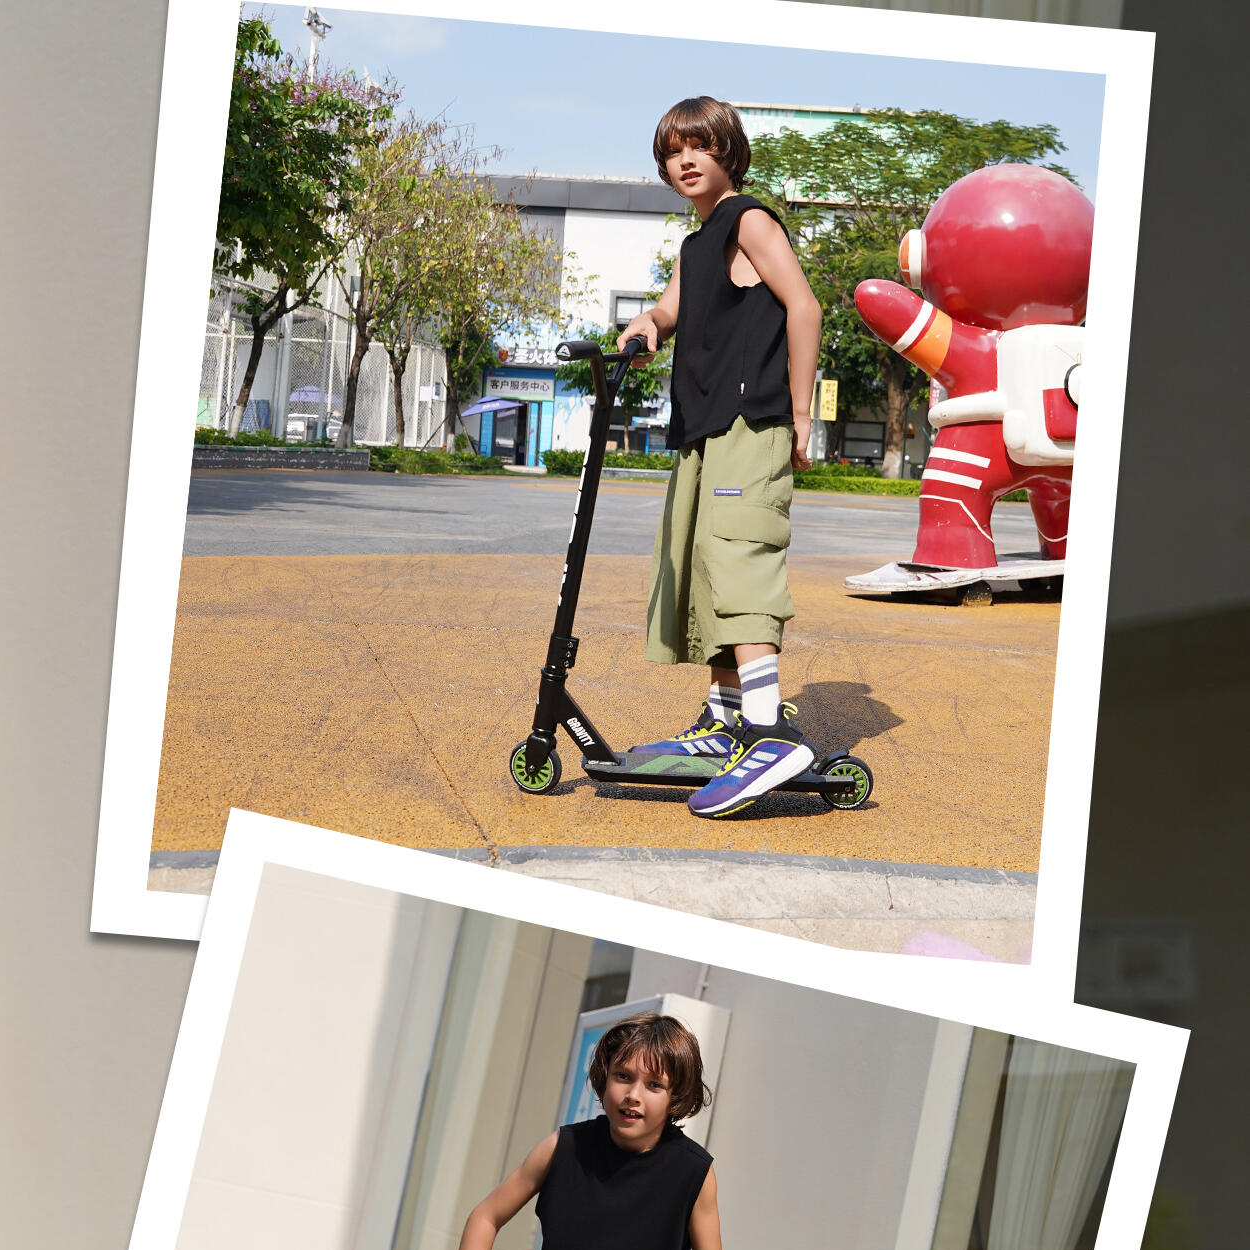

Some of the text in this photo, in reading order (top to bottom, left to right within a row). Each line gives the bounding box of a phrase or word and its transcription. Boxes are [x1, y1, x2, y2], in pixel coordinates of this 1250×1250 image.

[514, 348, 568, 366] 圣火体
[490, 379, 550, 392] 客户服务中心
[566, 717, 595, 746] GRAVITY
